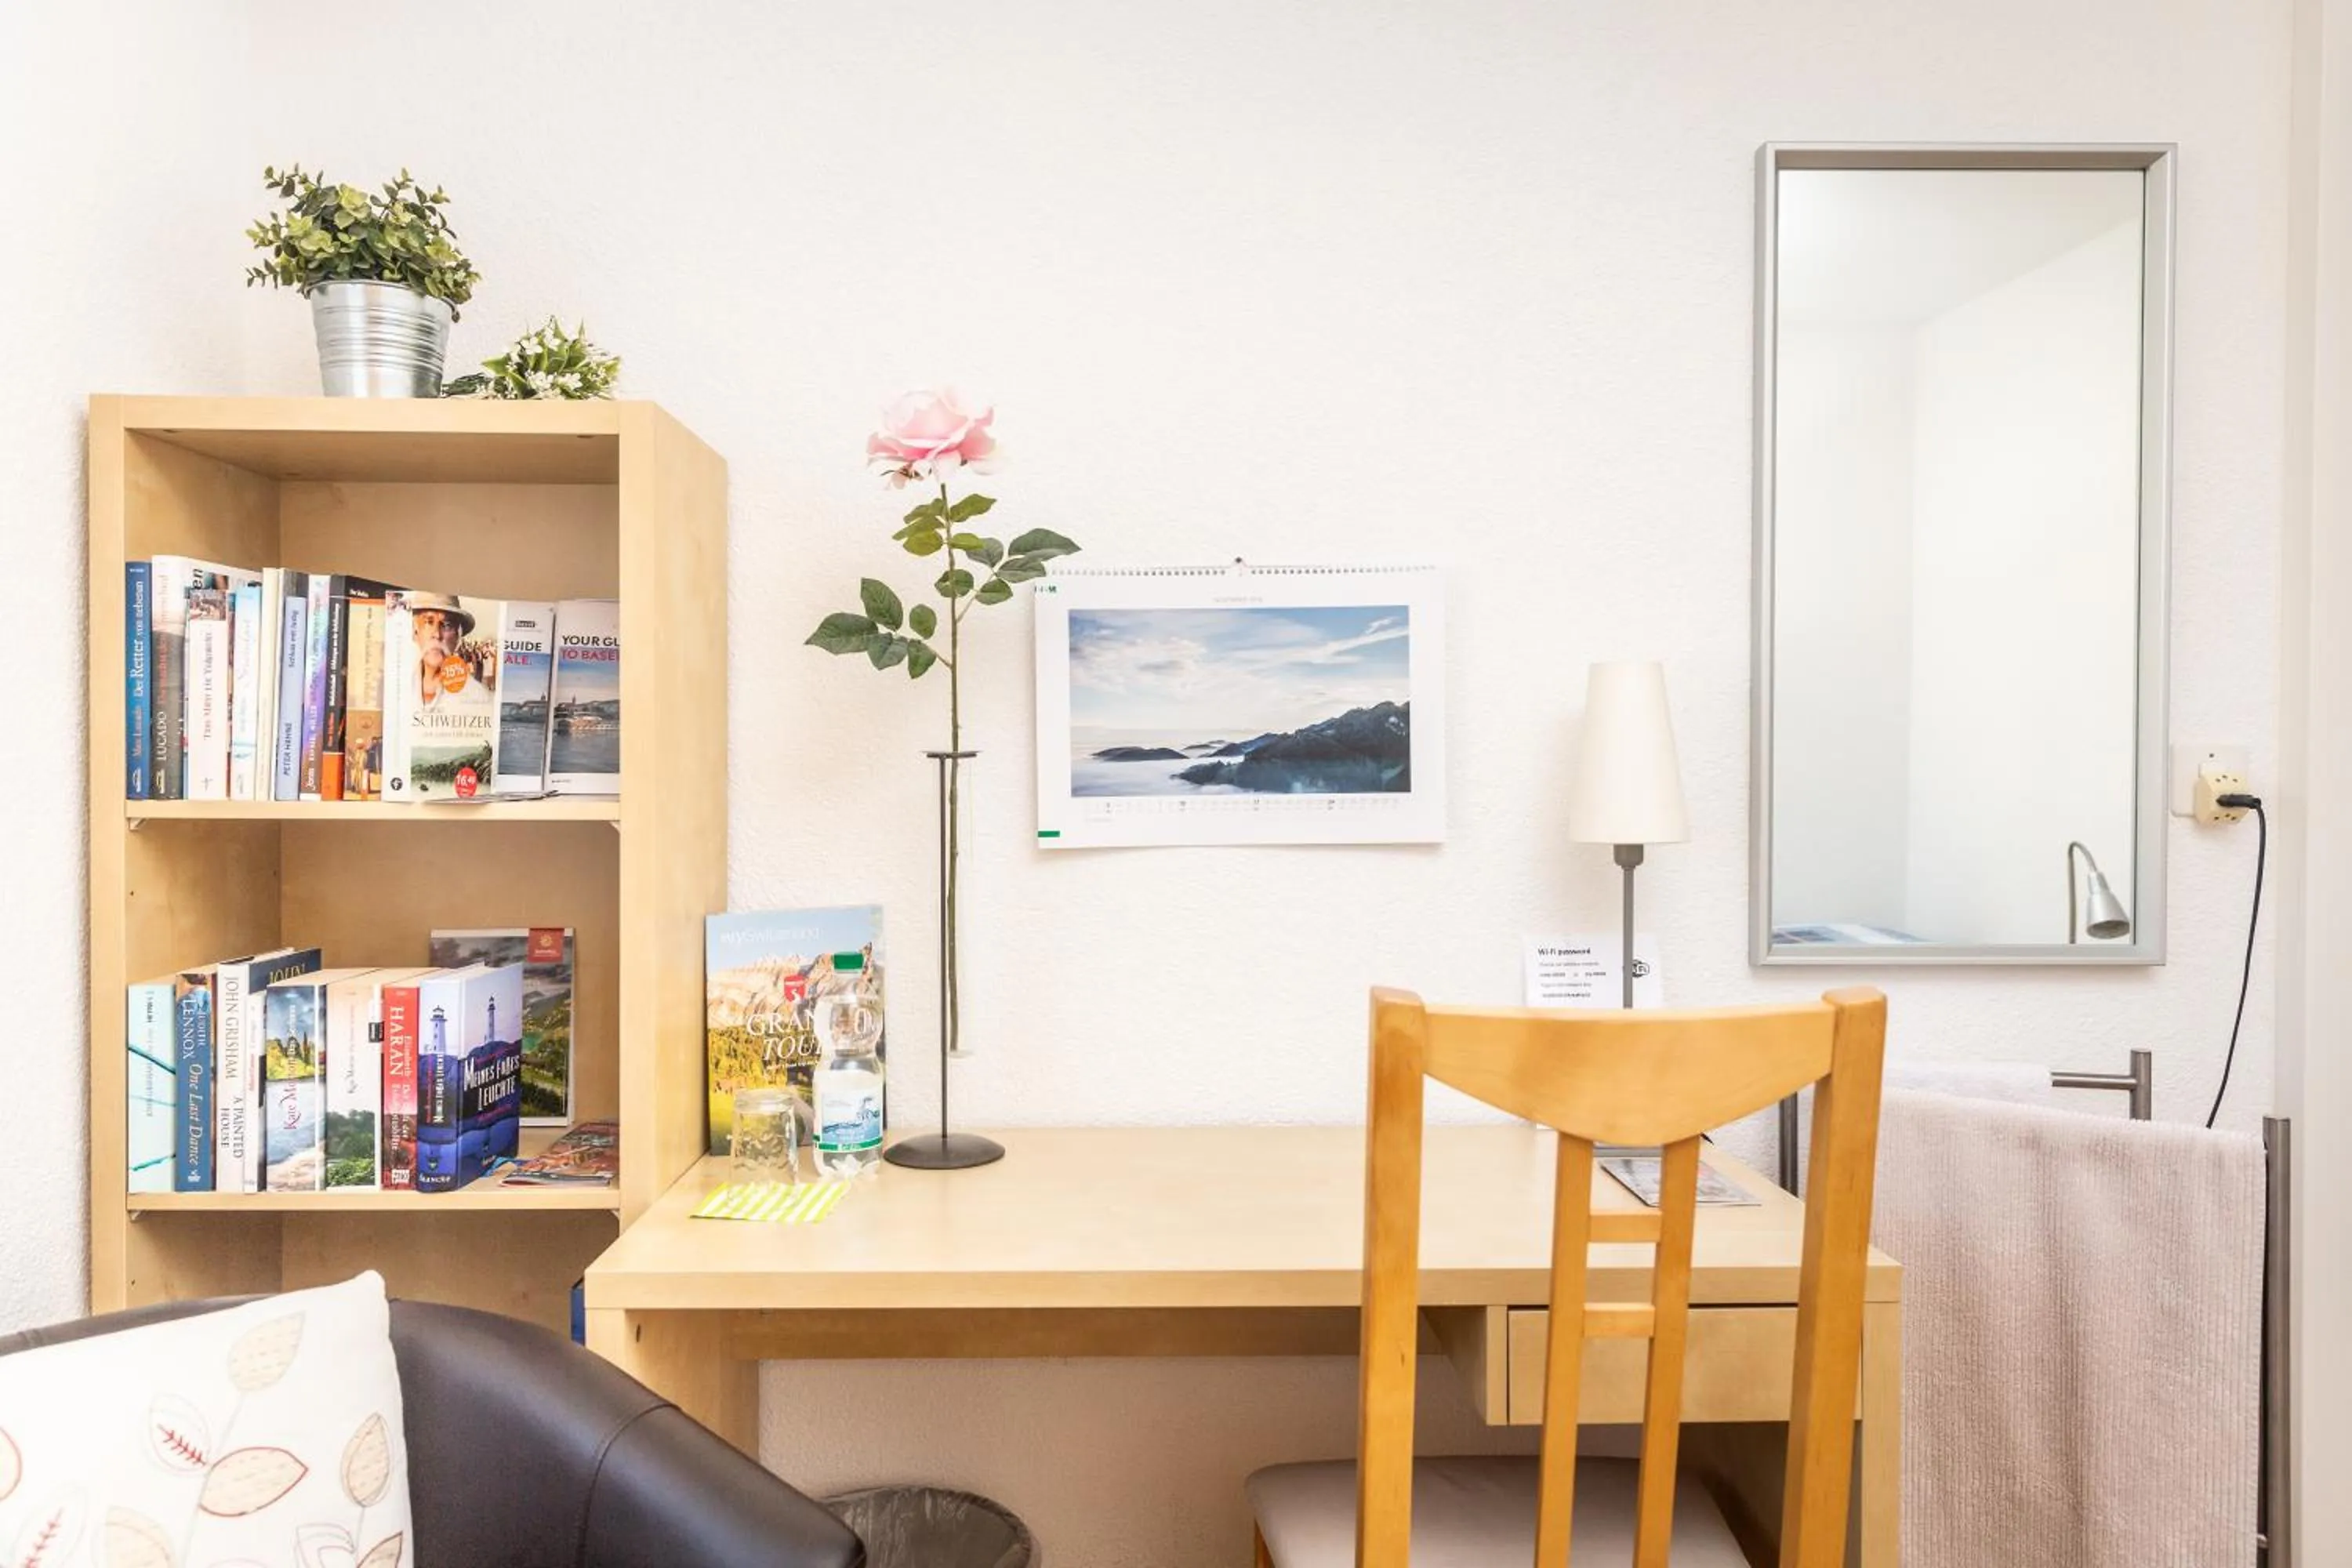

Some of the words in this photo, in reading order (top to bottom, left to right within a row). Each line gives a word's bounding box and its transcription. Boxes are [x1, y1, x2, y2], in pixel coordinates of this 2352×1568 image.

[130, 639, 144, 677] Retter
[562, 634, 601, 647] YOUR
[157, 710, 168, 761] LUCADO
[411, 714, 492, 728] SCHWEITZER
[224, 976, 240, 1013] JOHN
[182, 998, 197, 1060] LENNOX
[225, 1017, 240, 1079] GRISHAM
[390, 1006, 404, 1076] HARAN
[188, 1063, 203, 1090] One
[278, 1059, 298, 1107] Morton
[477, 1075, 516, 1111] LEUCHTE
[188, 1094, 203, 1121] Last
[284, 1105, 301, 1130] Kate
[188, 1125, 203, 1166] Dance
[220, 1107, 230, 1148] HOUSE
[233, 1107, 245, 1158] PAINTED
